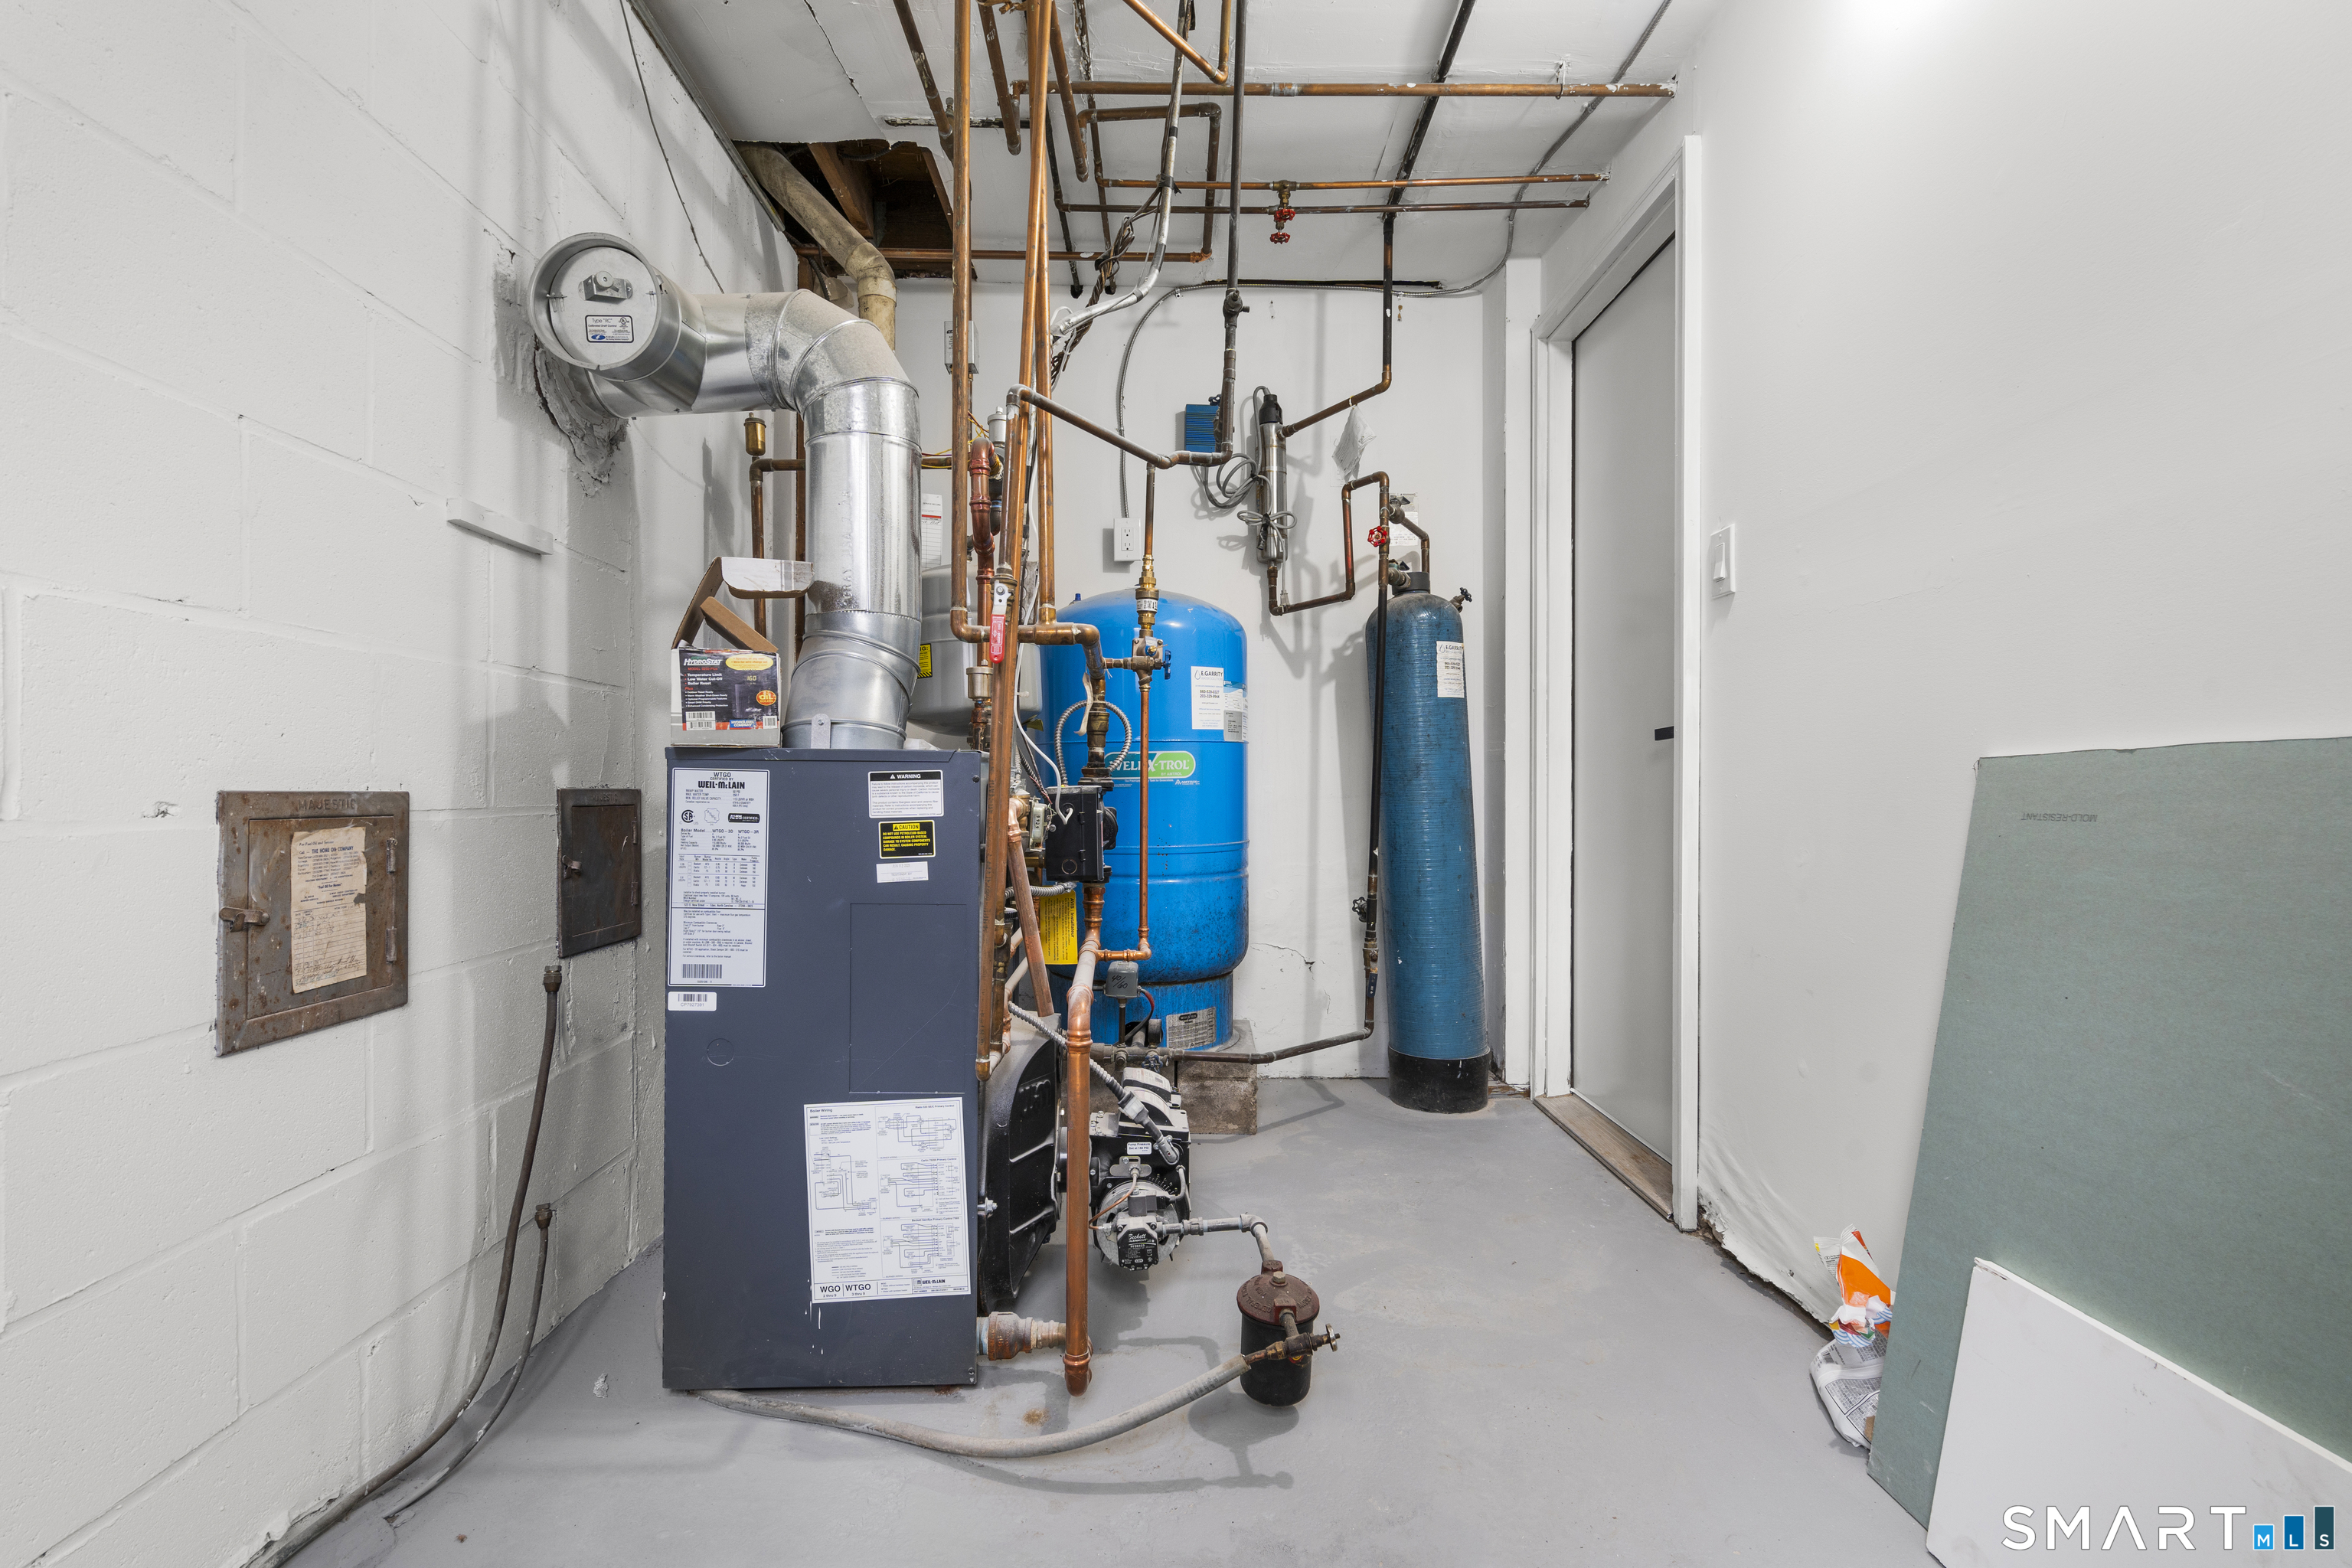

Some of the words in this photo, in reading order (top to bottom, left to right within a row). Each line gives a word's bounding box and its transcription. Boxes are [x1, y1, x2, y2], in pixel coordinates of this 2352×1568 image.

[298, 798, 356, 810] MAJESTIC
[2021, 813, 2098, 822] MOLD-RESISTANT
[1112, 974, 1128, 988] 40/60
